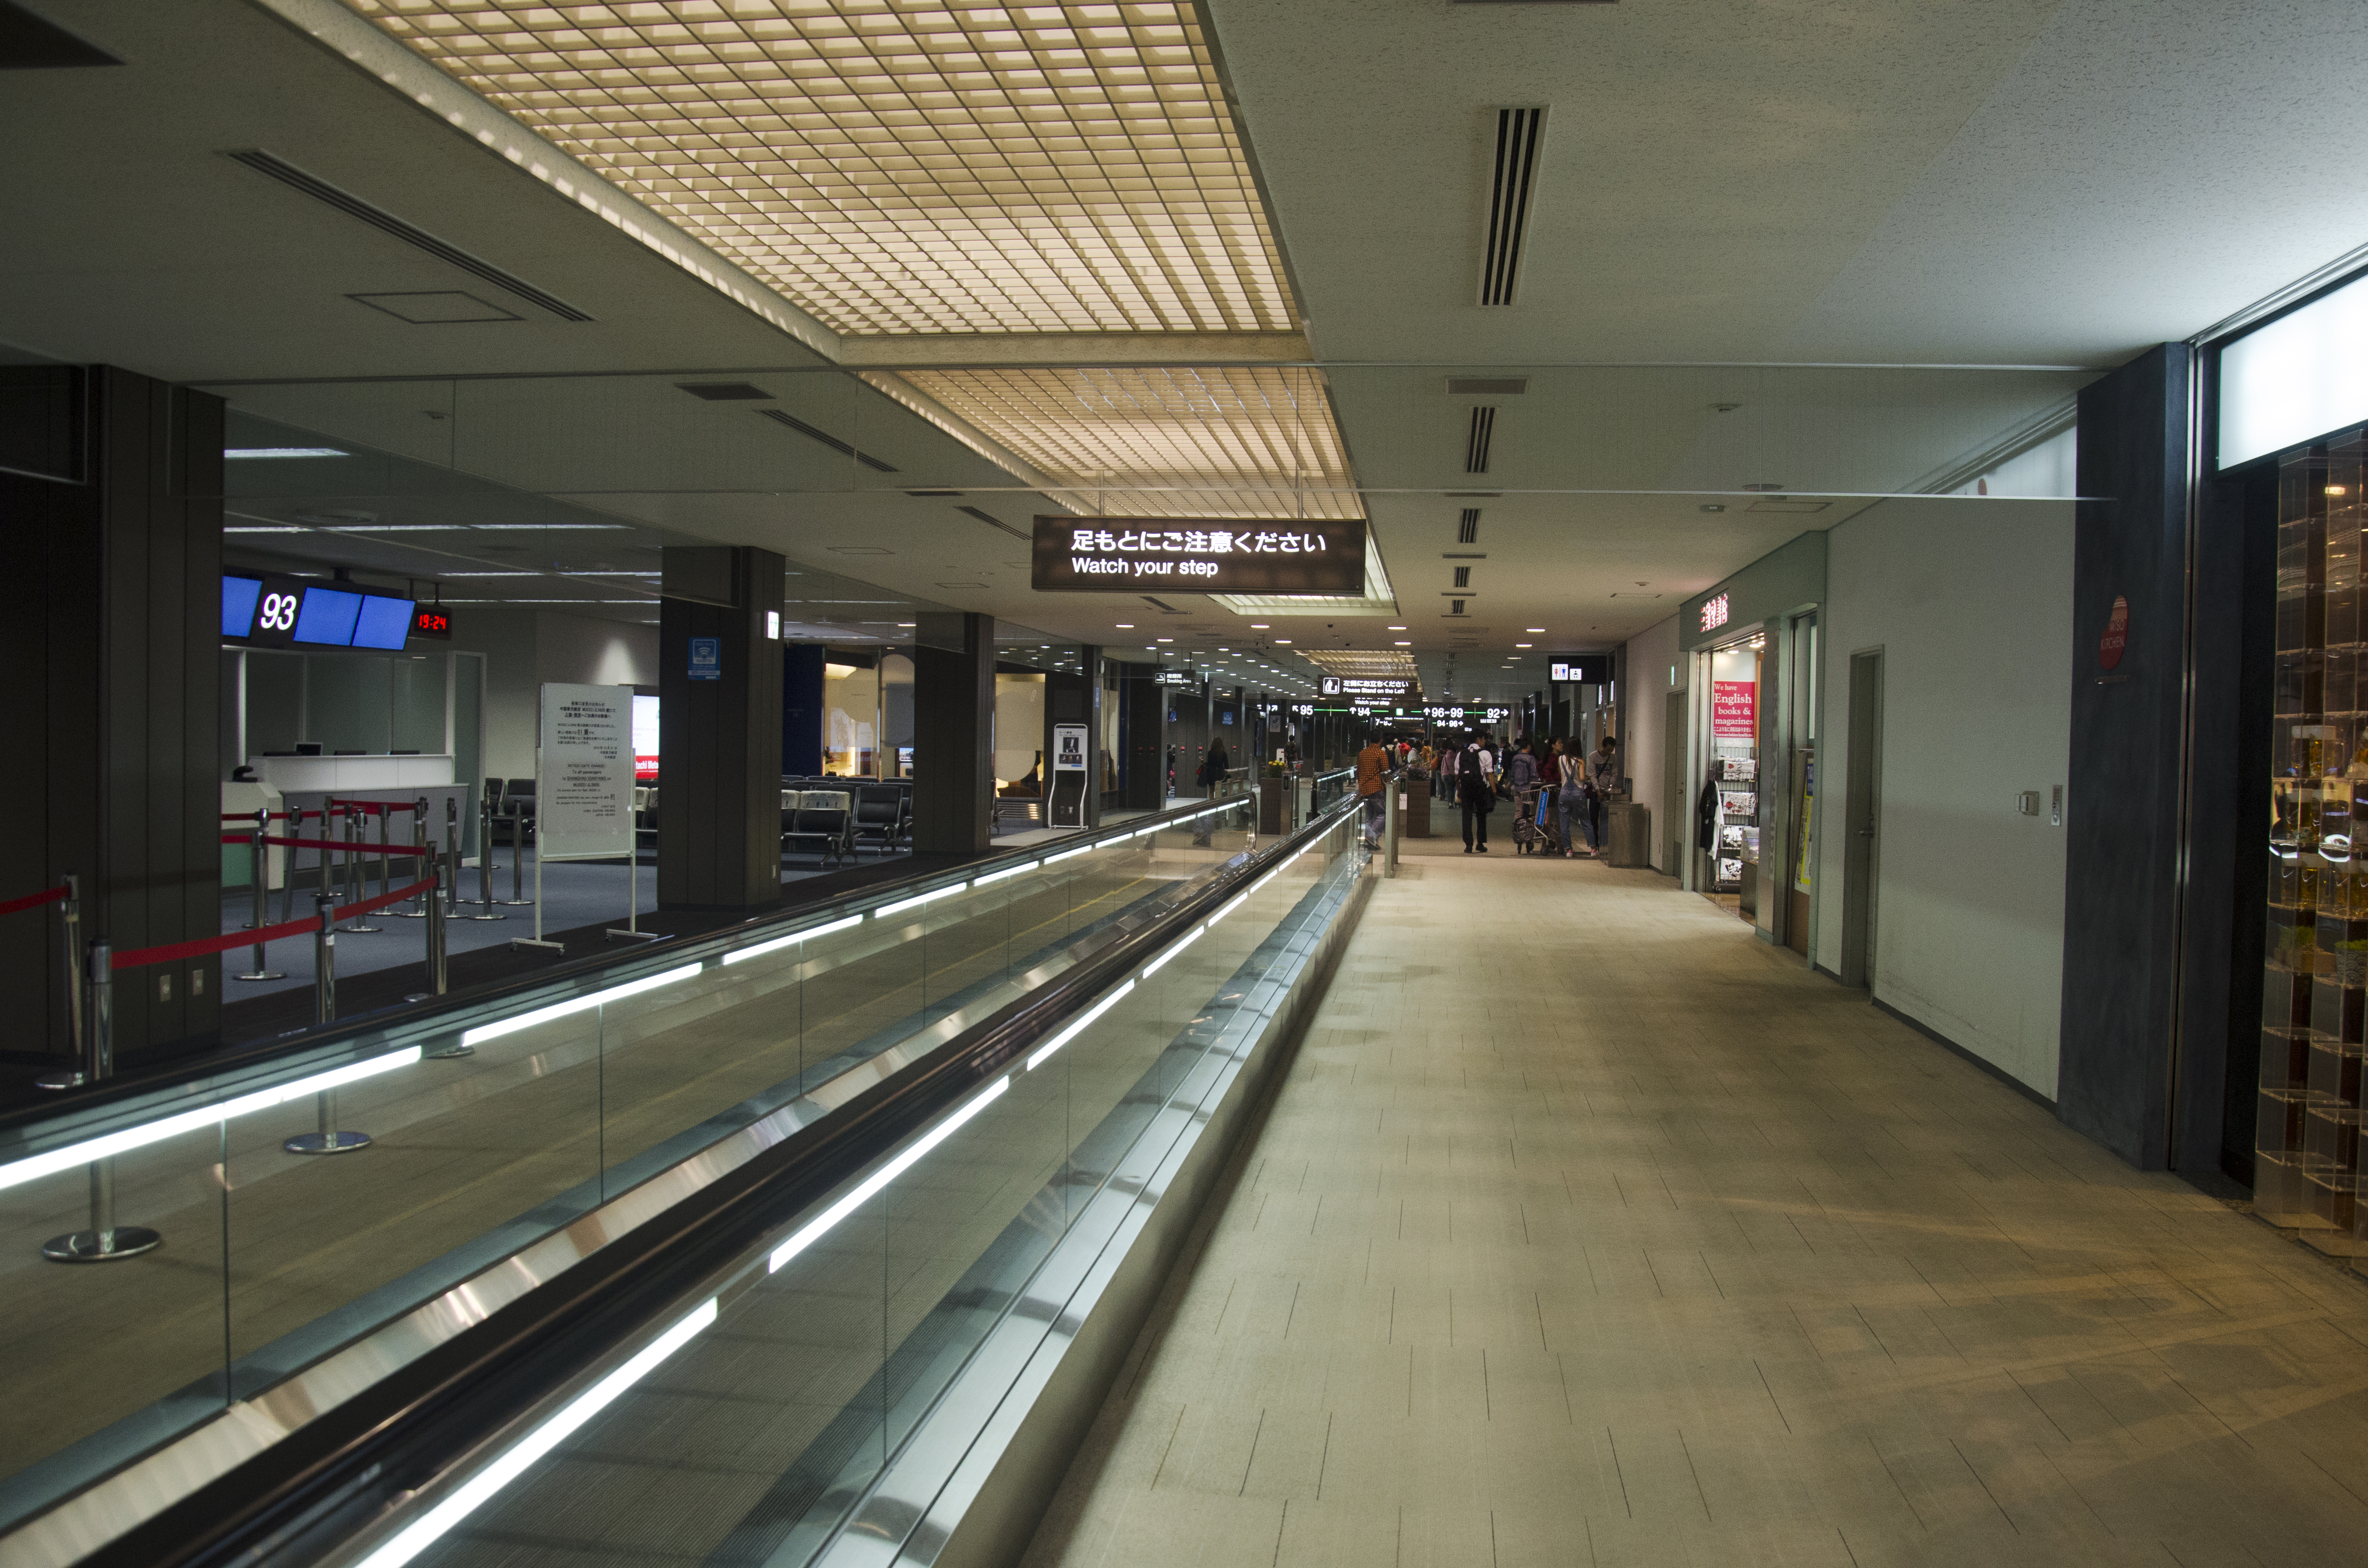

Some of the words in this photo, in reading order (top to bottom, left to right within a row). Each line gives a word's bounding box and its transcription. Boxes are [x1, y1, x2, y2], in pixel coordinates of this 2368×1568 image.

[1071, 530, 1326, 553] 足もとにご注意ください
[1072, 557, 1129, 574] Watch
[1135, 562, 1174, 577] your
[1179, 559, 1219, 578] step
[260, 593, 296, 630] 93
[419, 614, 446, 630] 19:24
[1714, 693, 1752, 705] English
[1300, 705, 1313, 715] 95
[1358, 707, 1370, 716] 94
[1431, 708, 1463, 718] 96-99
[1487, 709, 1500, 719] 92
[1715, 718, 1753, 726] magazines
